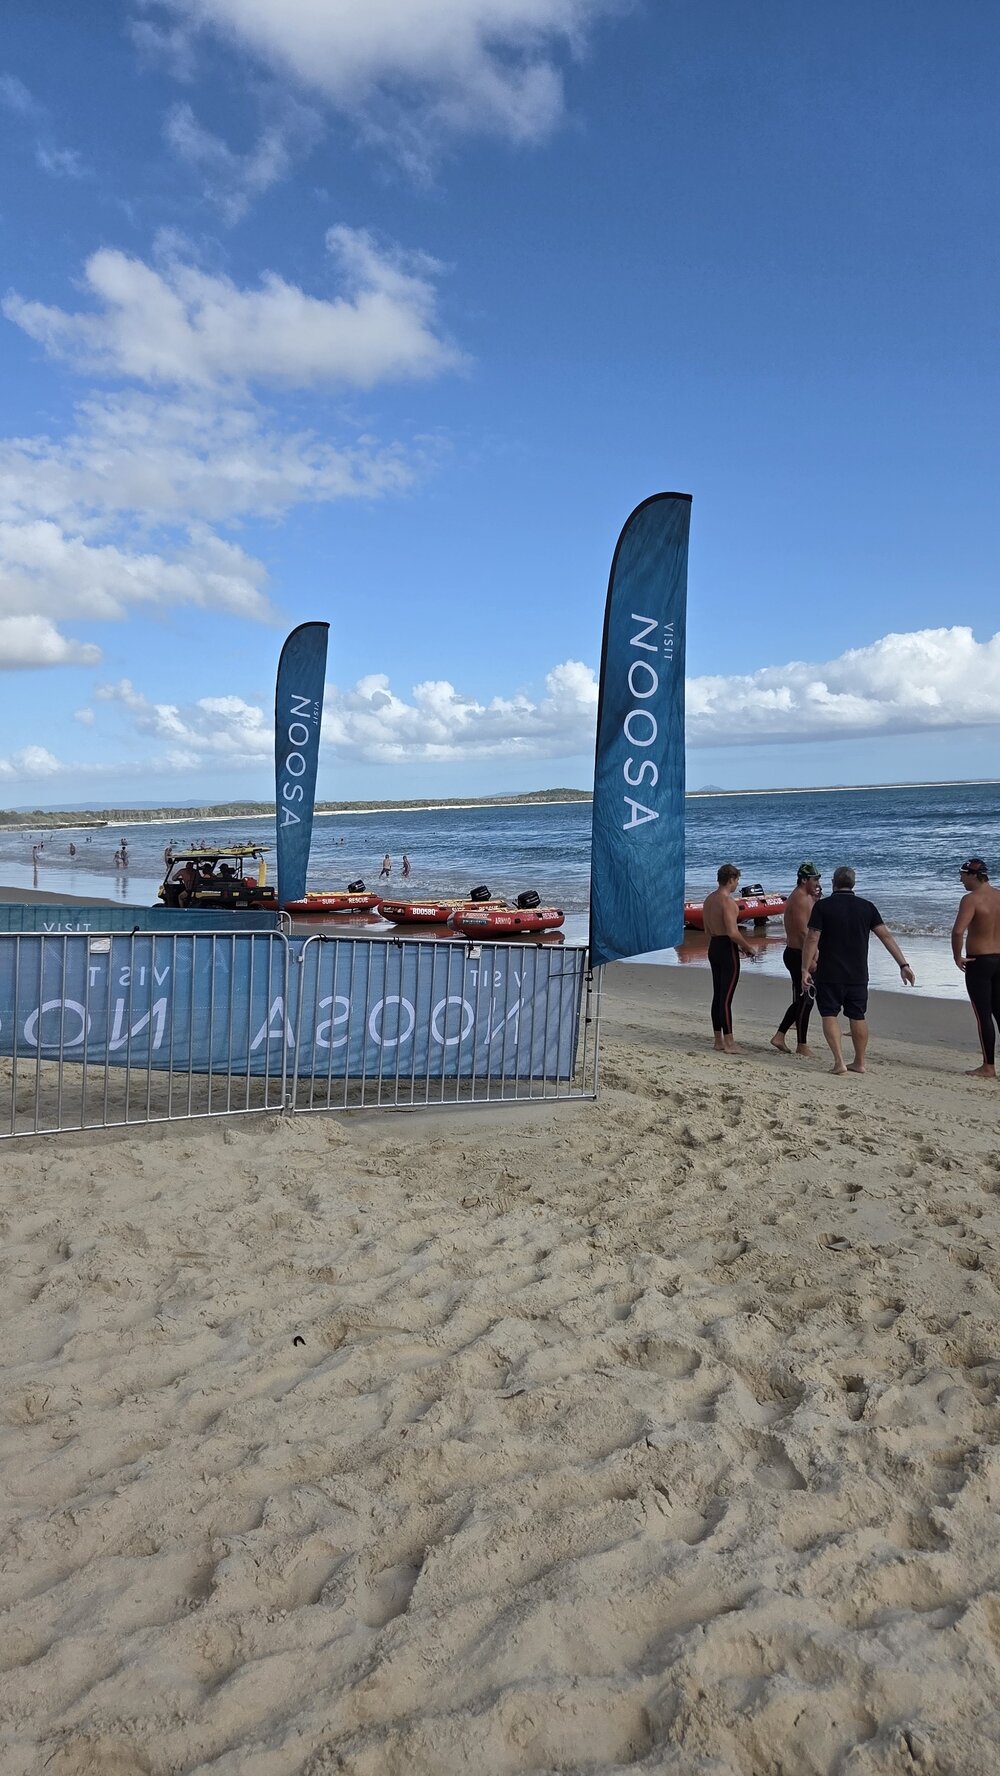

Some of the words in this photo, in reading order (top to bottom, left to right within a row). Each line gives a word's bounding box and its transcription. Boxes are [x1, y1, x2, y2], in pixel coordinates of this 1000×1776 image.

[664, 622, 674, 661] VISIT
[312, 701, 320, 726] VISIT
[622, 613, 660, 830] NOOSA
[279, 694, 312, 828] NOOSA
[43, 922, 92, 932] VISIT
